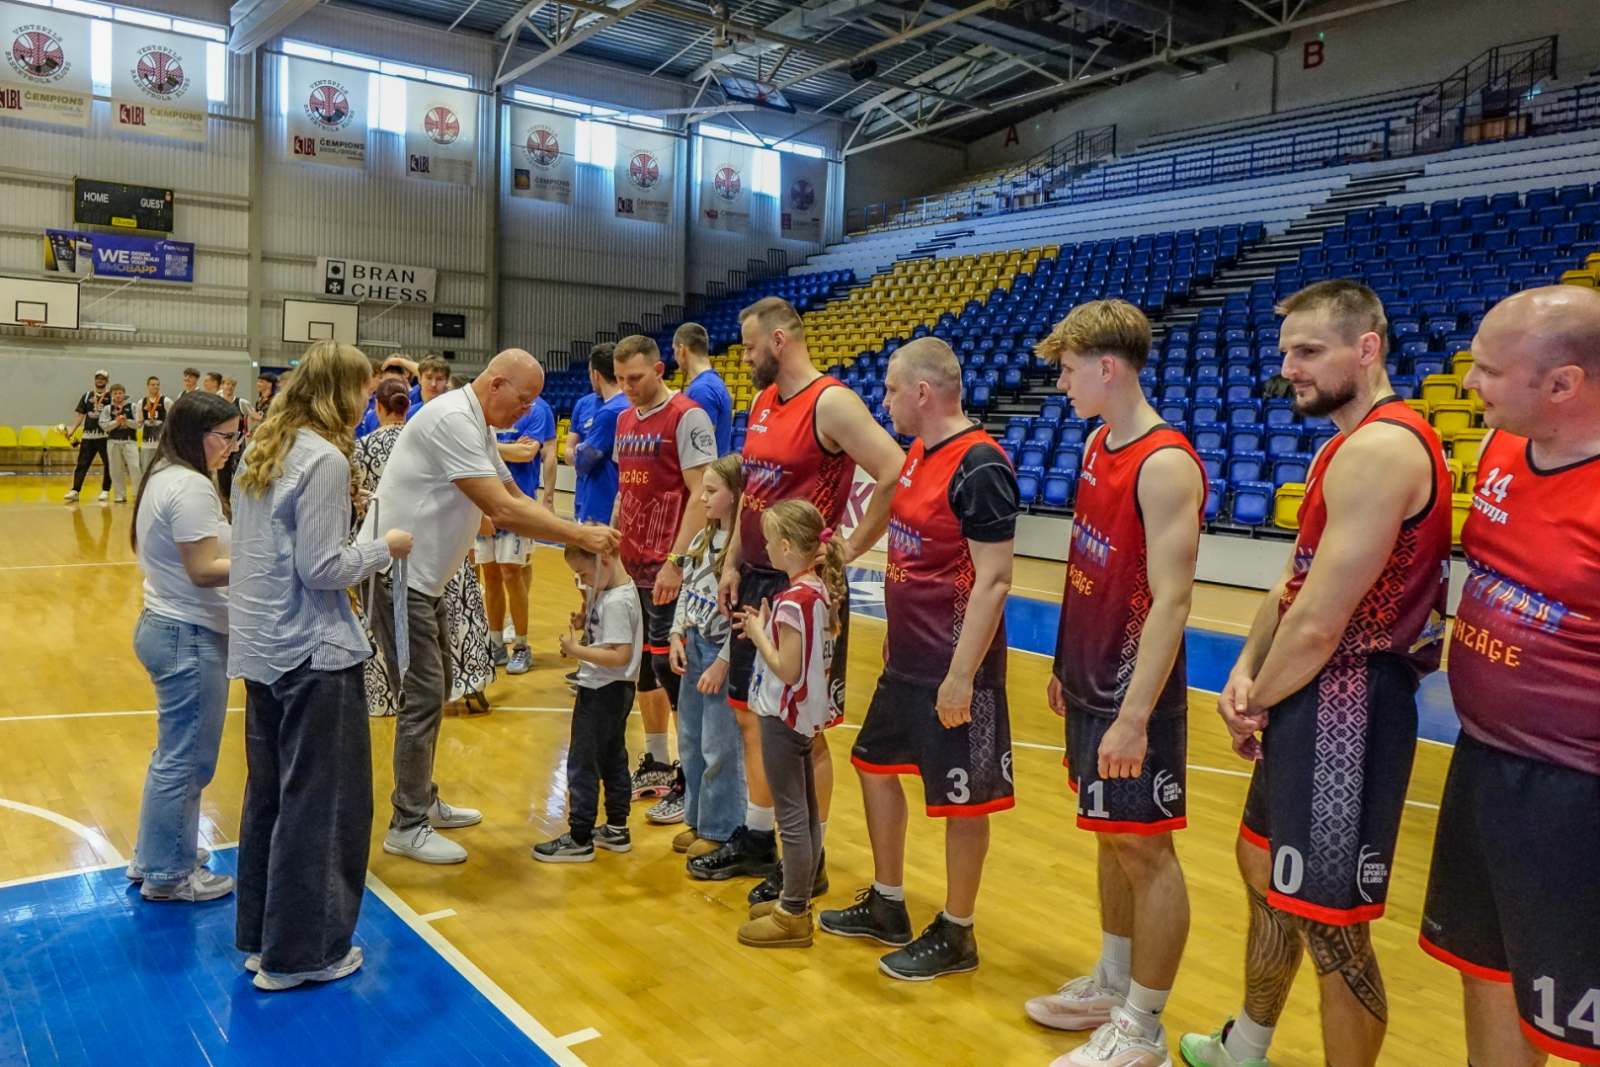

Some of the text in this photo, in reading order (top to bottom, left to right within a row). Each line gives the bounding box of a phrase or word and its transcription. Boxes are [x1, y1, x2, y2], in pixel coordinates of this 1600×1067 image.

[13, 24, 63, 42] VENTSPILS
[137, 45, 183, 61] VENTSPILS
[1303, 40, 1325, 70] B
[5, 51, 71, 84] BASKETBOLA KLUBS
[130, 69, 190, 101] BASKETBOLA KLUBS
[309, 80, 349, 95] VENTSPILS
[6, 88, 22, 110] LBL
[24, 90, 84, 106] ČEMPIONS
[131, 106, 146, 126] LBL
[319, 137, 365, 150] ČEMPIONS
[1004, 124, 1020, 147] A
[83, 191, 110, 204] HOME
[140, 198, 165, 209] GUEST
[98, 248, 130, 264] WE
[353, 265, 415, 284] BRAN
[351, 283, 427, 303] CHESS
[1479, 467, 1514, 503] 14
[946, 767, 971, 804] 3
[1273, 845, 1304, 894] 0
[1363, 862, 1386, 870] POPES
[1363, 869, 1388, 877] SPORTA
[1533, 975, 1600, 1046] 14
